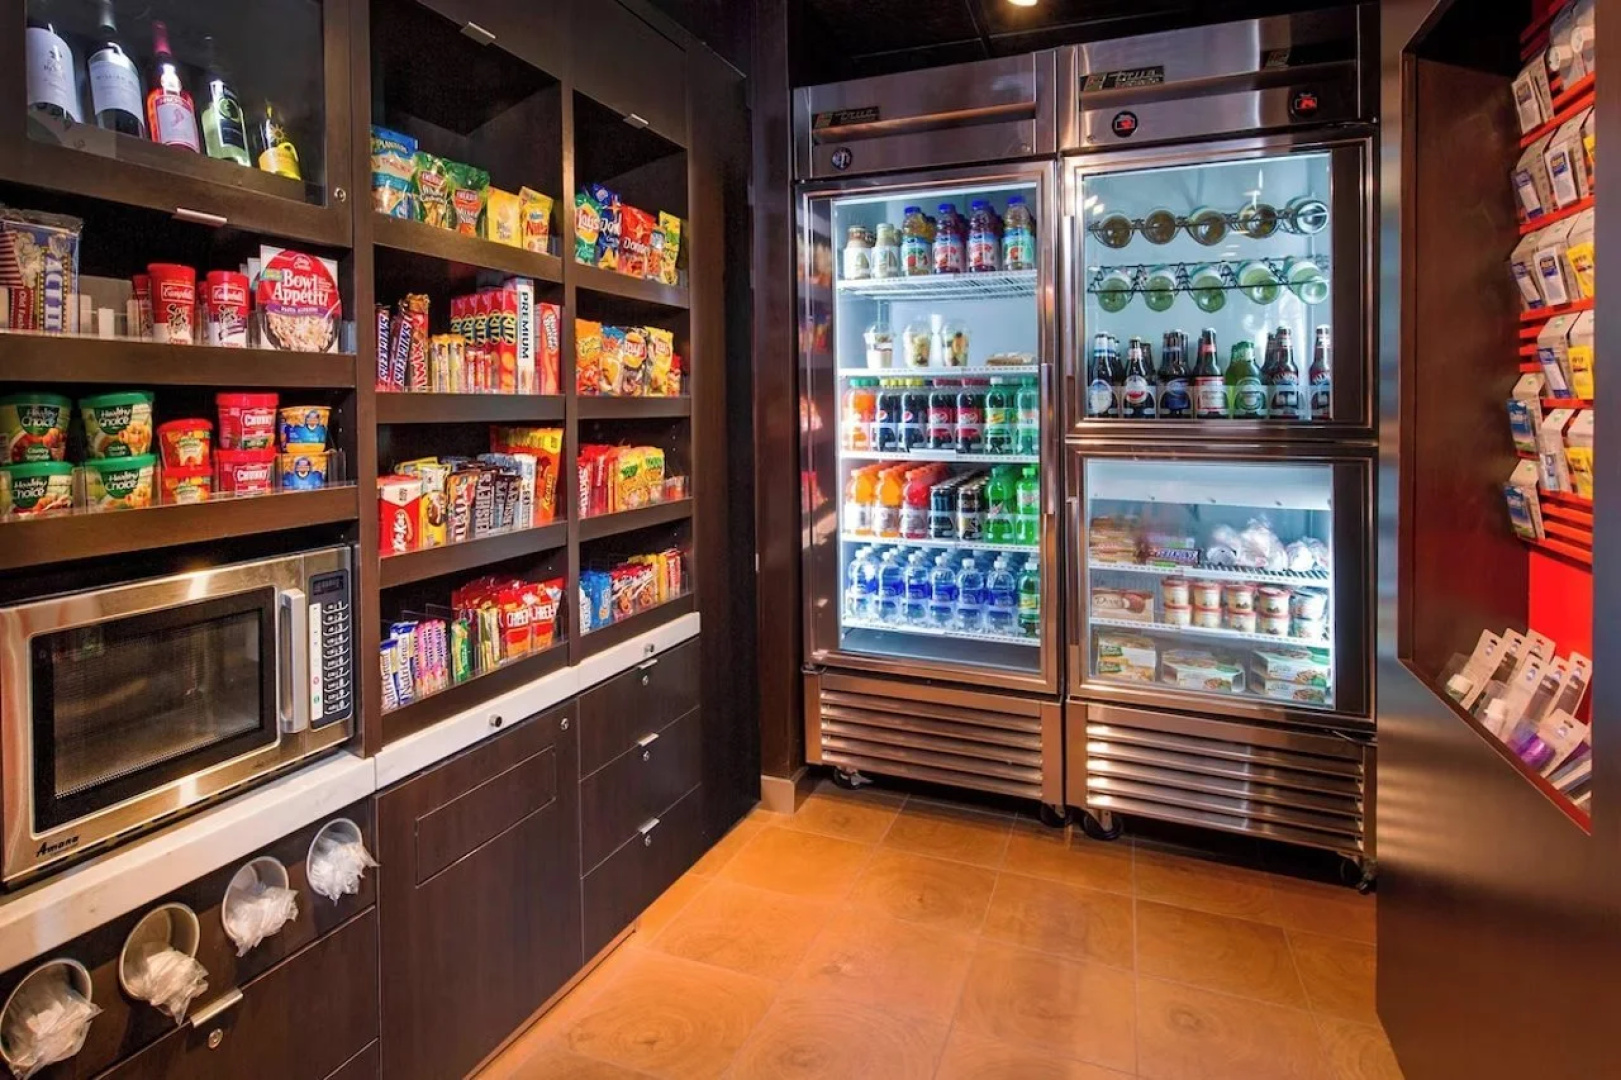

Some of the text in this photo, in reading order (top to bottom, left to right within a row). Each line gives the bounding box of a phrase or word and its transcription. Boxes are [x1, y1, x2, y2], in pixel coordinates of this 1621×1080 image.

[282, 268, 318, 290] Bowl
[502, 314, 516, 344] RITZ
[521, 291, 529, 359] PREMIUM
[379, 314, 389, 381] SNICKERS
[395, 320, 412, 386] SNICKERS
[100, 407, 132, 418] Healthy
[22, 415, 55, 427] Choice
[99, 415, 129, 427] Choice
[109, 470, 139, 482] Healthy
[237, 470, 267, 481] CHUNKY
[14, 477, 48, 489] Healthy
[105, 479, 138, 491] Choice
[12, 485, 45, 499] Choice
[37, 836, 79, 858] Amana
